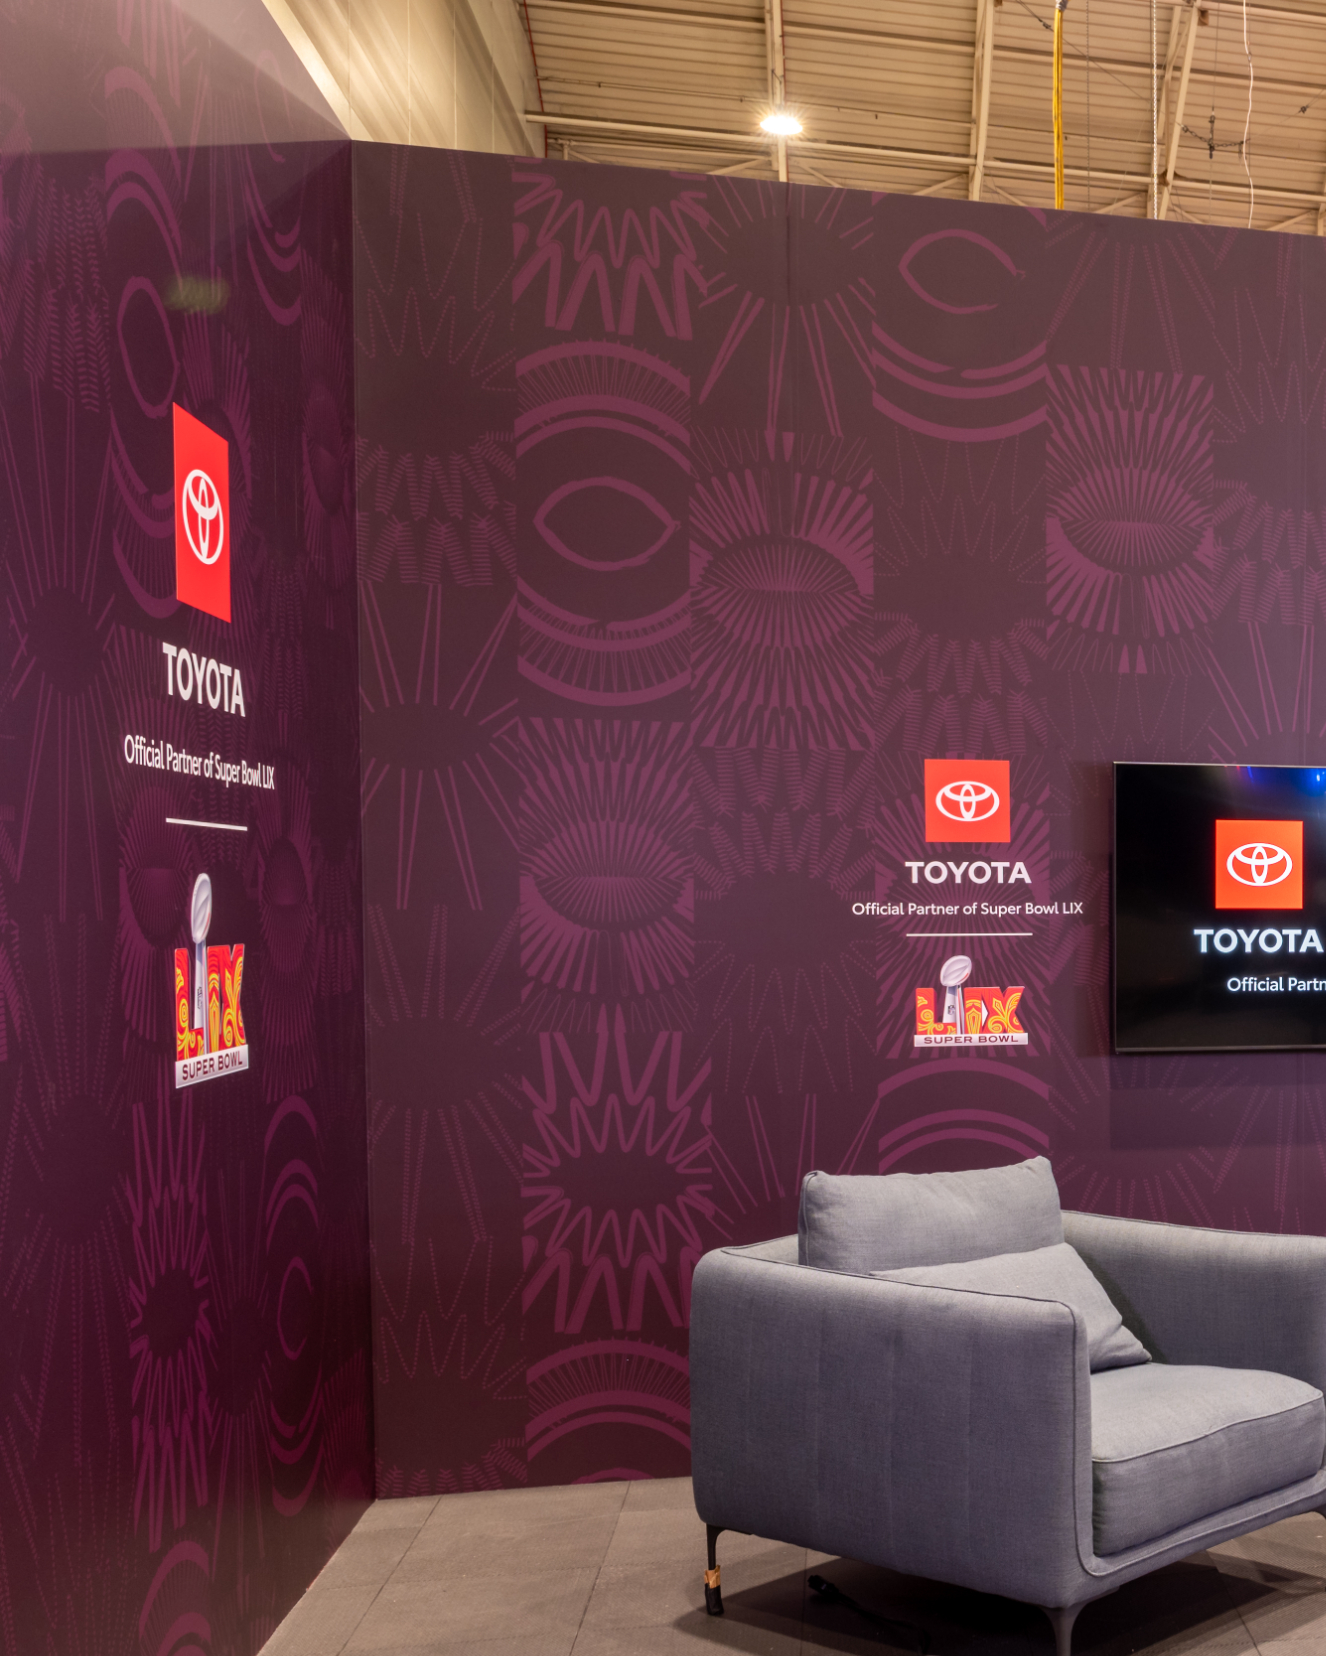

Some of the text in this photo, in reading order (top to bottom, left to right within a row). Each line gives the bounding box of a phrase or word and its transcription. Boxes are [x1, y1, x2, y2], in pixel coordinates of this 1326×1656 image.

[162, 641, 246, 718] TOYOTA
[124, 734, 275, 790] Official Partner of Super Bowl LIX
[904, 860, 1032, 885] TOYOTA
[851, 901, 1084, 918] Official Partner of Super Bowl LIX
[1193, 927, 1325, 954] TOYOTA
[1226, 976, 1285, 992] Official
[175, 943, 247, 1061] LIX
[915, 986, 1026, 1035] LIX
[923, 1034, 1019, 1045] SUPER BOWL
[182, 1050, 244, 1081] SUPER BOWL
